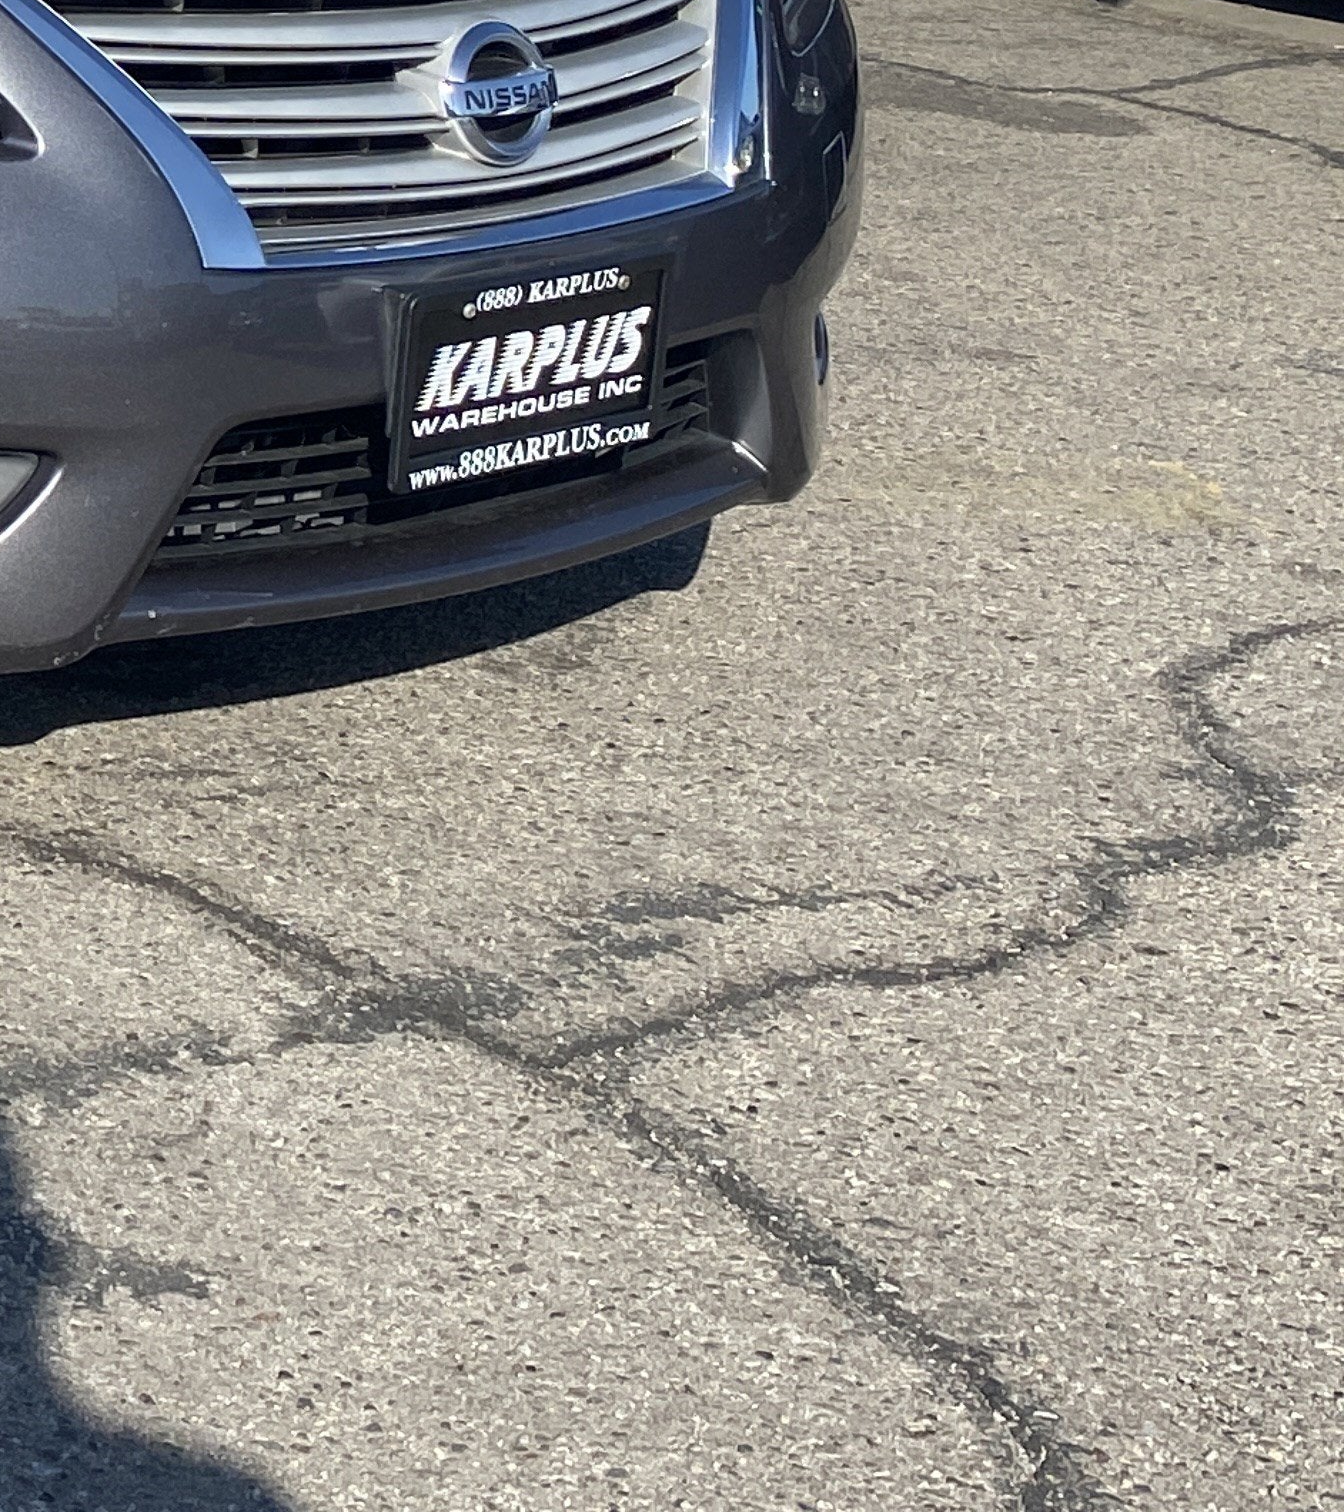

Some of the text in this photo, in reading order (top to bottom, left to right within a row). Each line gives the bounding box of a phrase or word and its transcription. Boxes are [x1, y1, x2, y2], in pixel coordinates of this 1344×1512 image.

[464, 74, 557, 111] NISSAN
[475, 267, 620, 313] (888) KARPLUS
[413, 305, 652, 412] KARPLUS
[411, 374, 644, 438] WAREHOUSE INC
